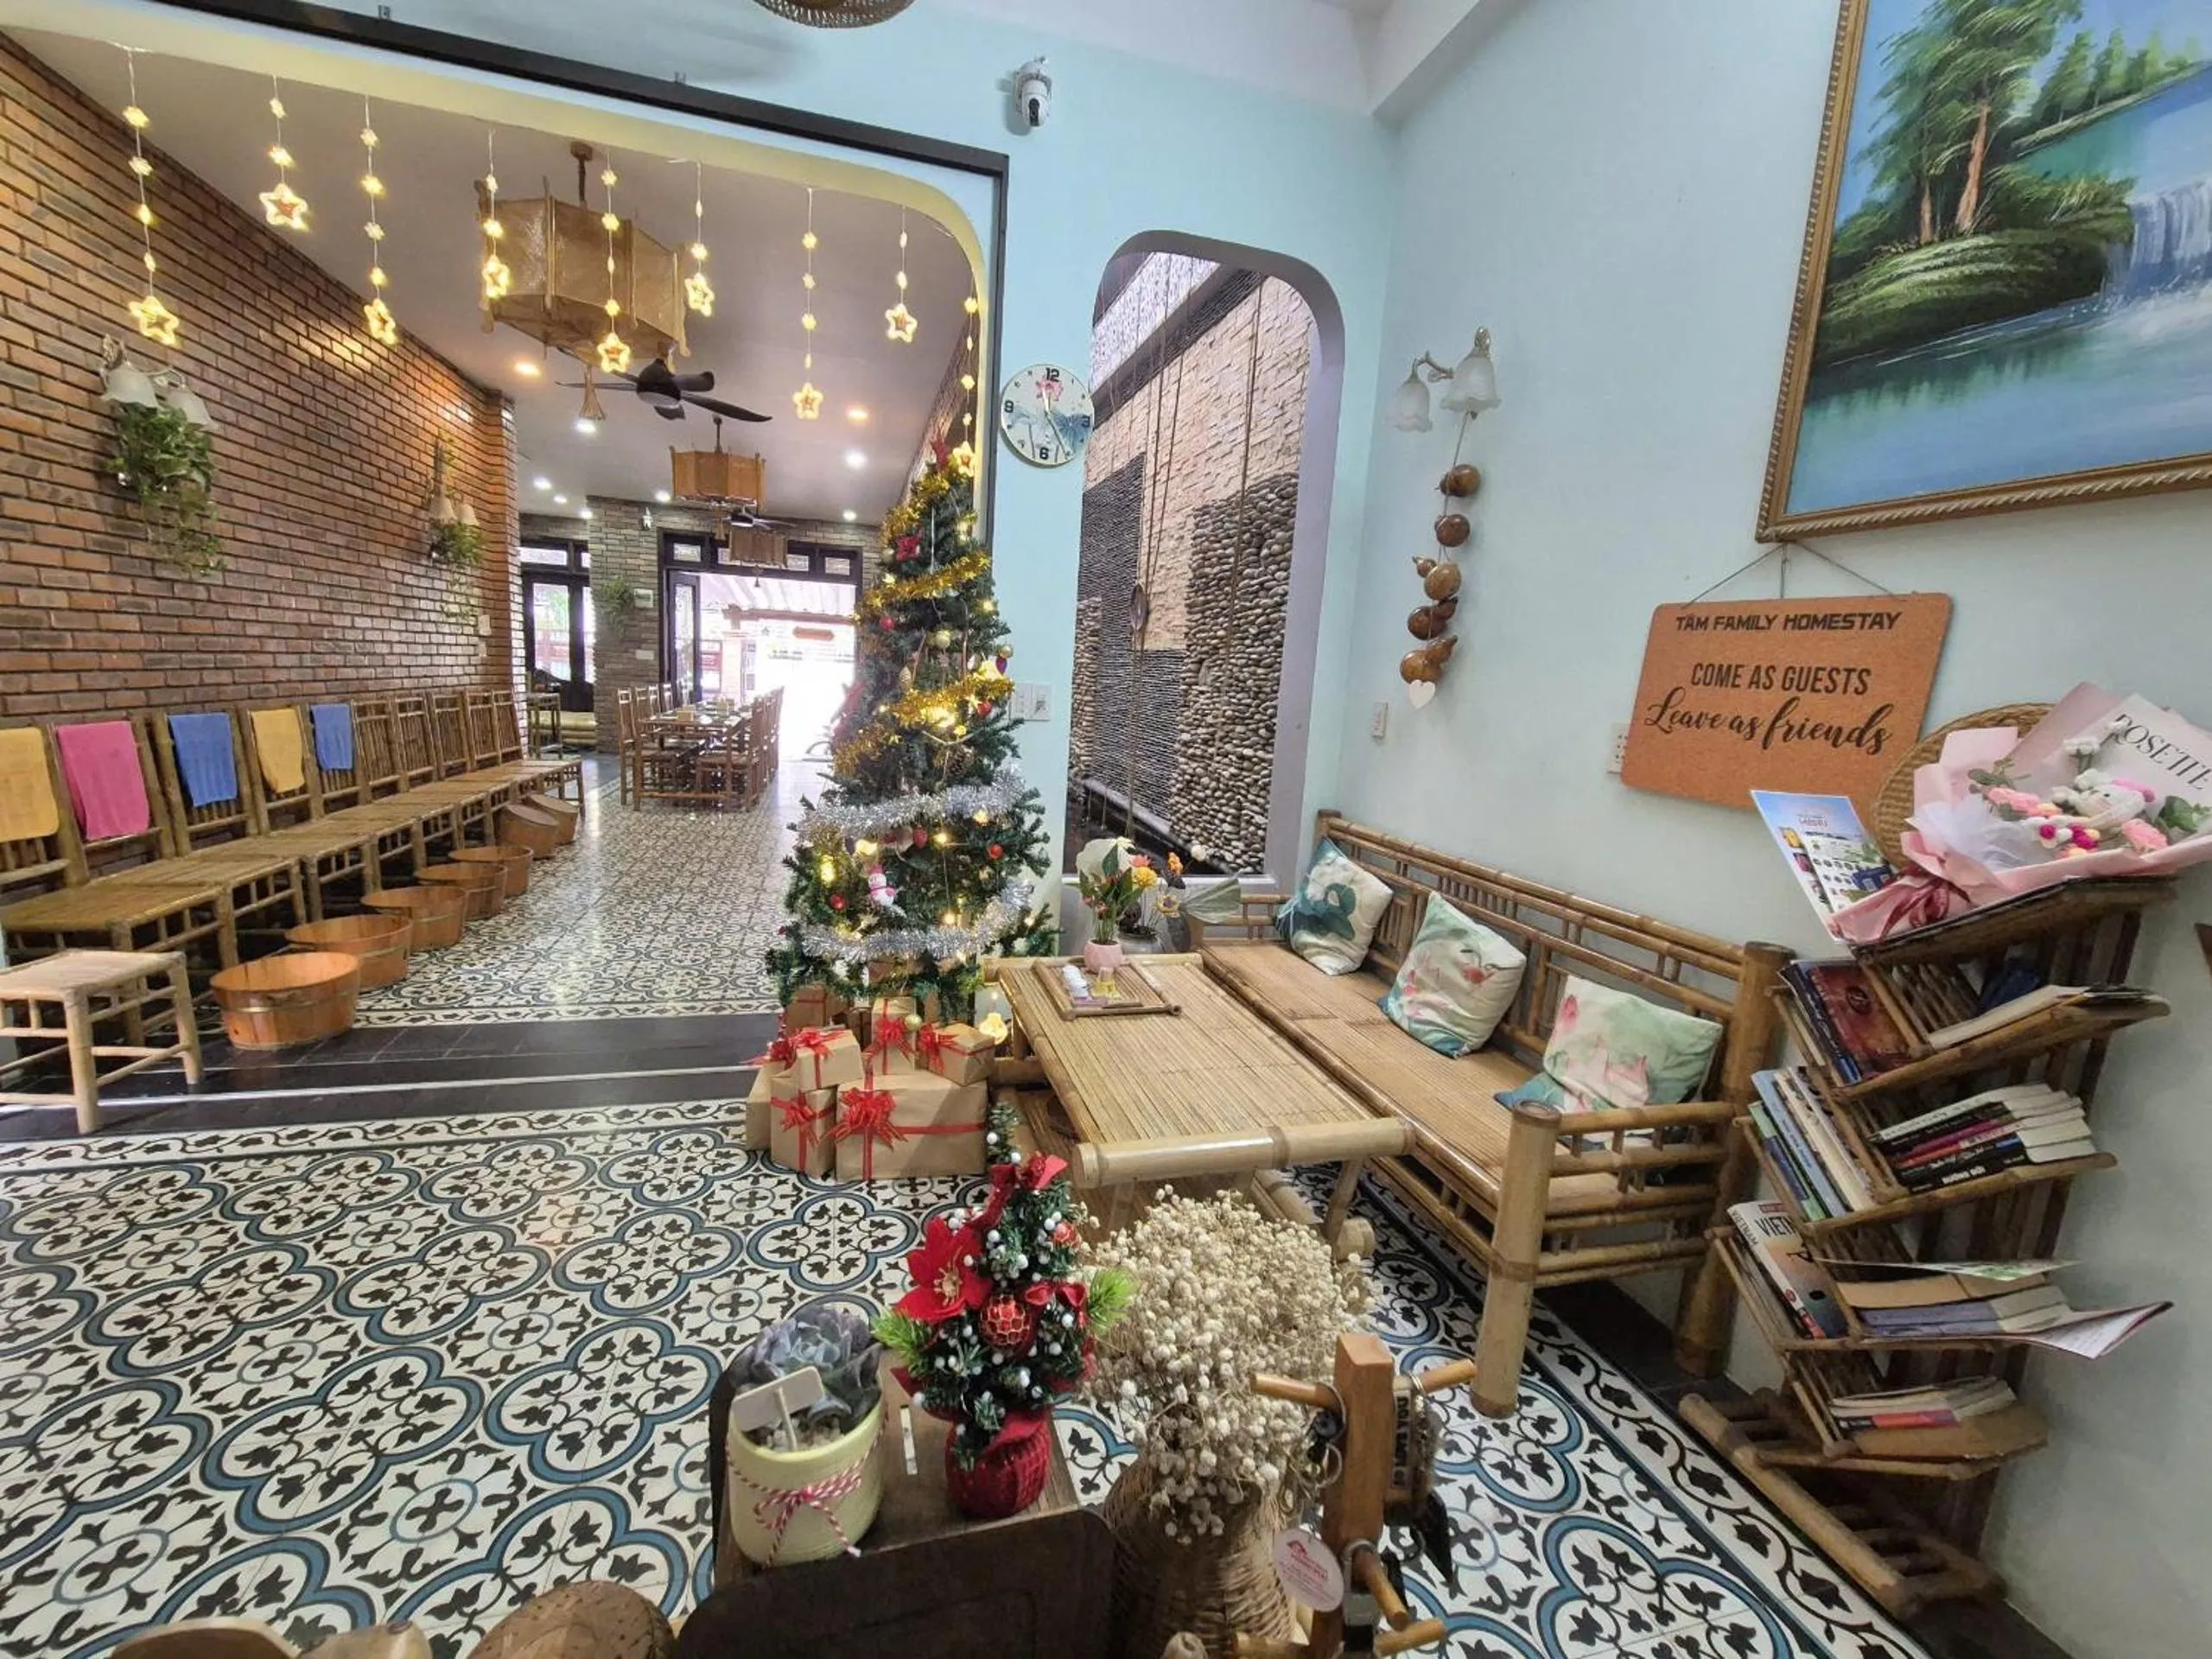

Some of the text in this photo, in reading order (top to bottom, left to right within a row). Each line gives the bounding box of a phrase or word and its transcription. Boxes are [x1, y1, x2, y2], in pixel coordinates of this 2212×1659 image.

[1046, 367, 1059, 382] 12
[1039, 446, 1049, 460] 6
[1713, 614, 1779, 631] FAMILY
[1783, 612, 1903, 631] HOMESTAY
[1691, 663, 1872, 696] COME AS GUESTS
[1644, 686, 1894, 756] Leave as friends
